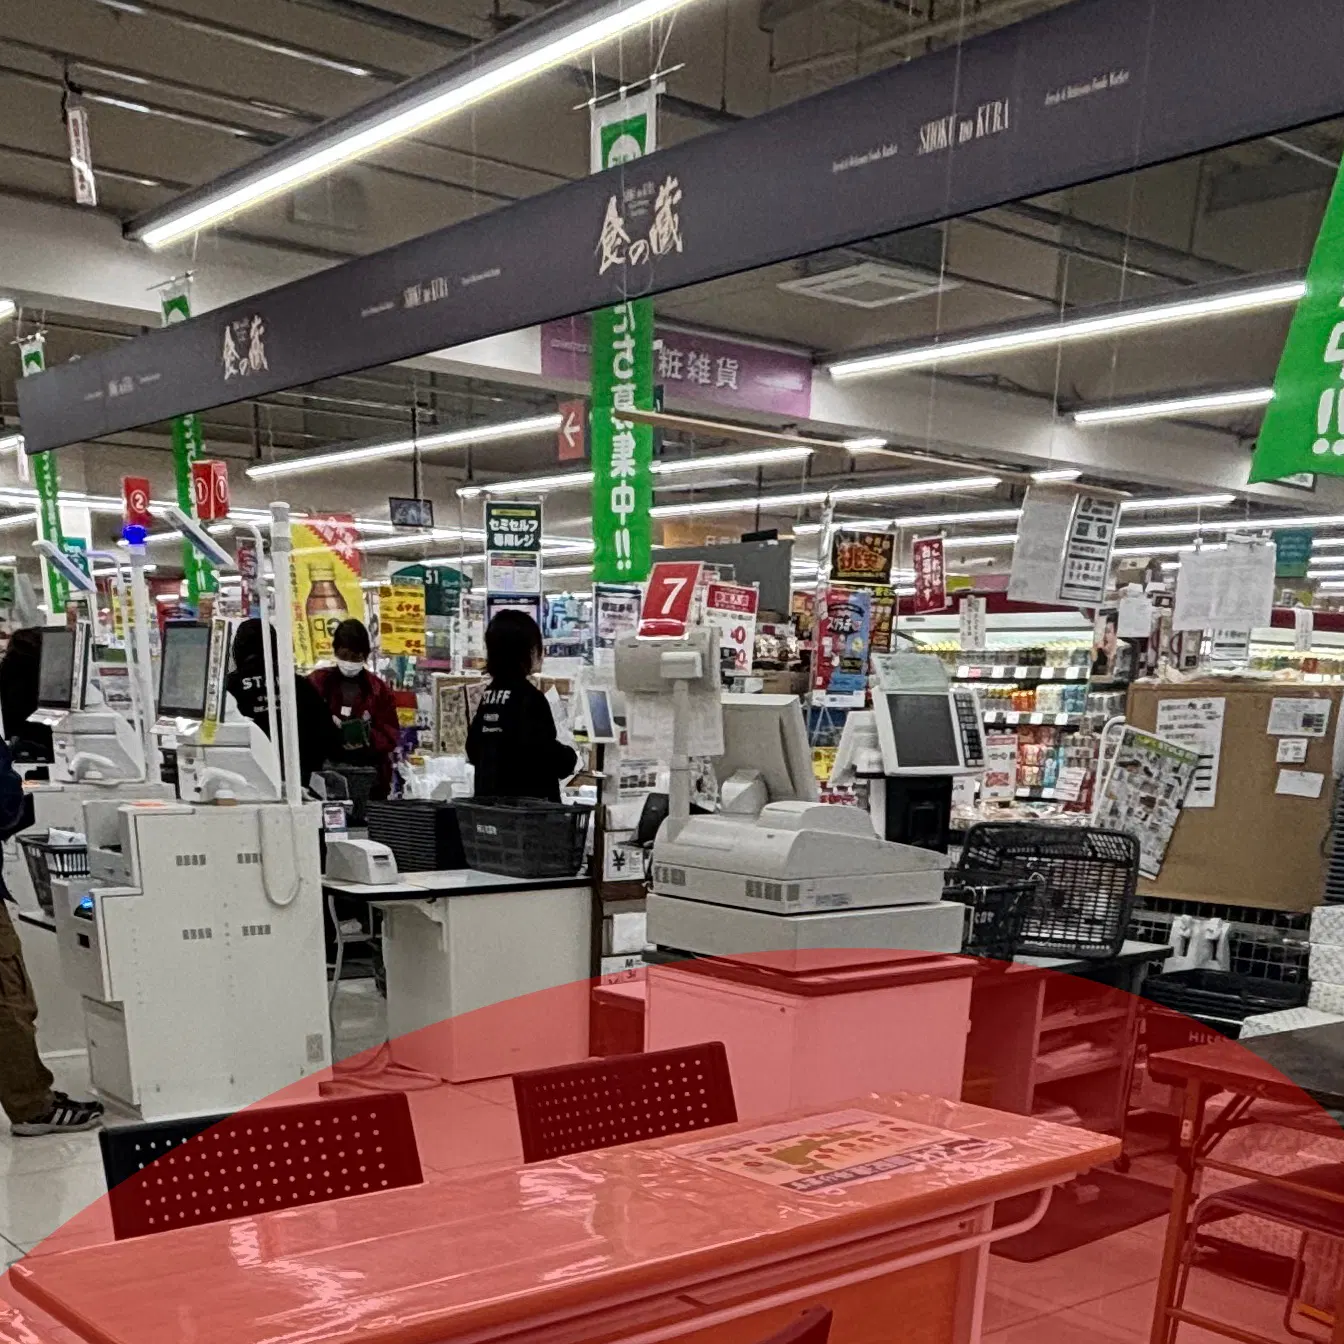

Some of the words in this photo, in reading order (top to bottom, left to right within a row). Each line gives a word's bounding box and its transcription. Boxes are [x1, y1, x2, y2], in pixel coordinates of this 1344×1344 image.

[657, 346, 741, 391] 粧雑貨
[488, 517, 539, 533] セミセルフ
[660, 577, 688, 615] 7
